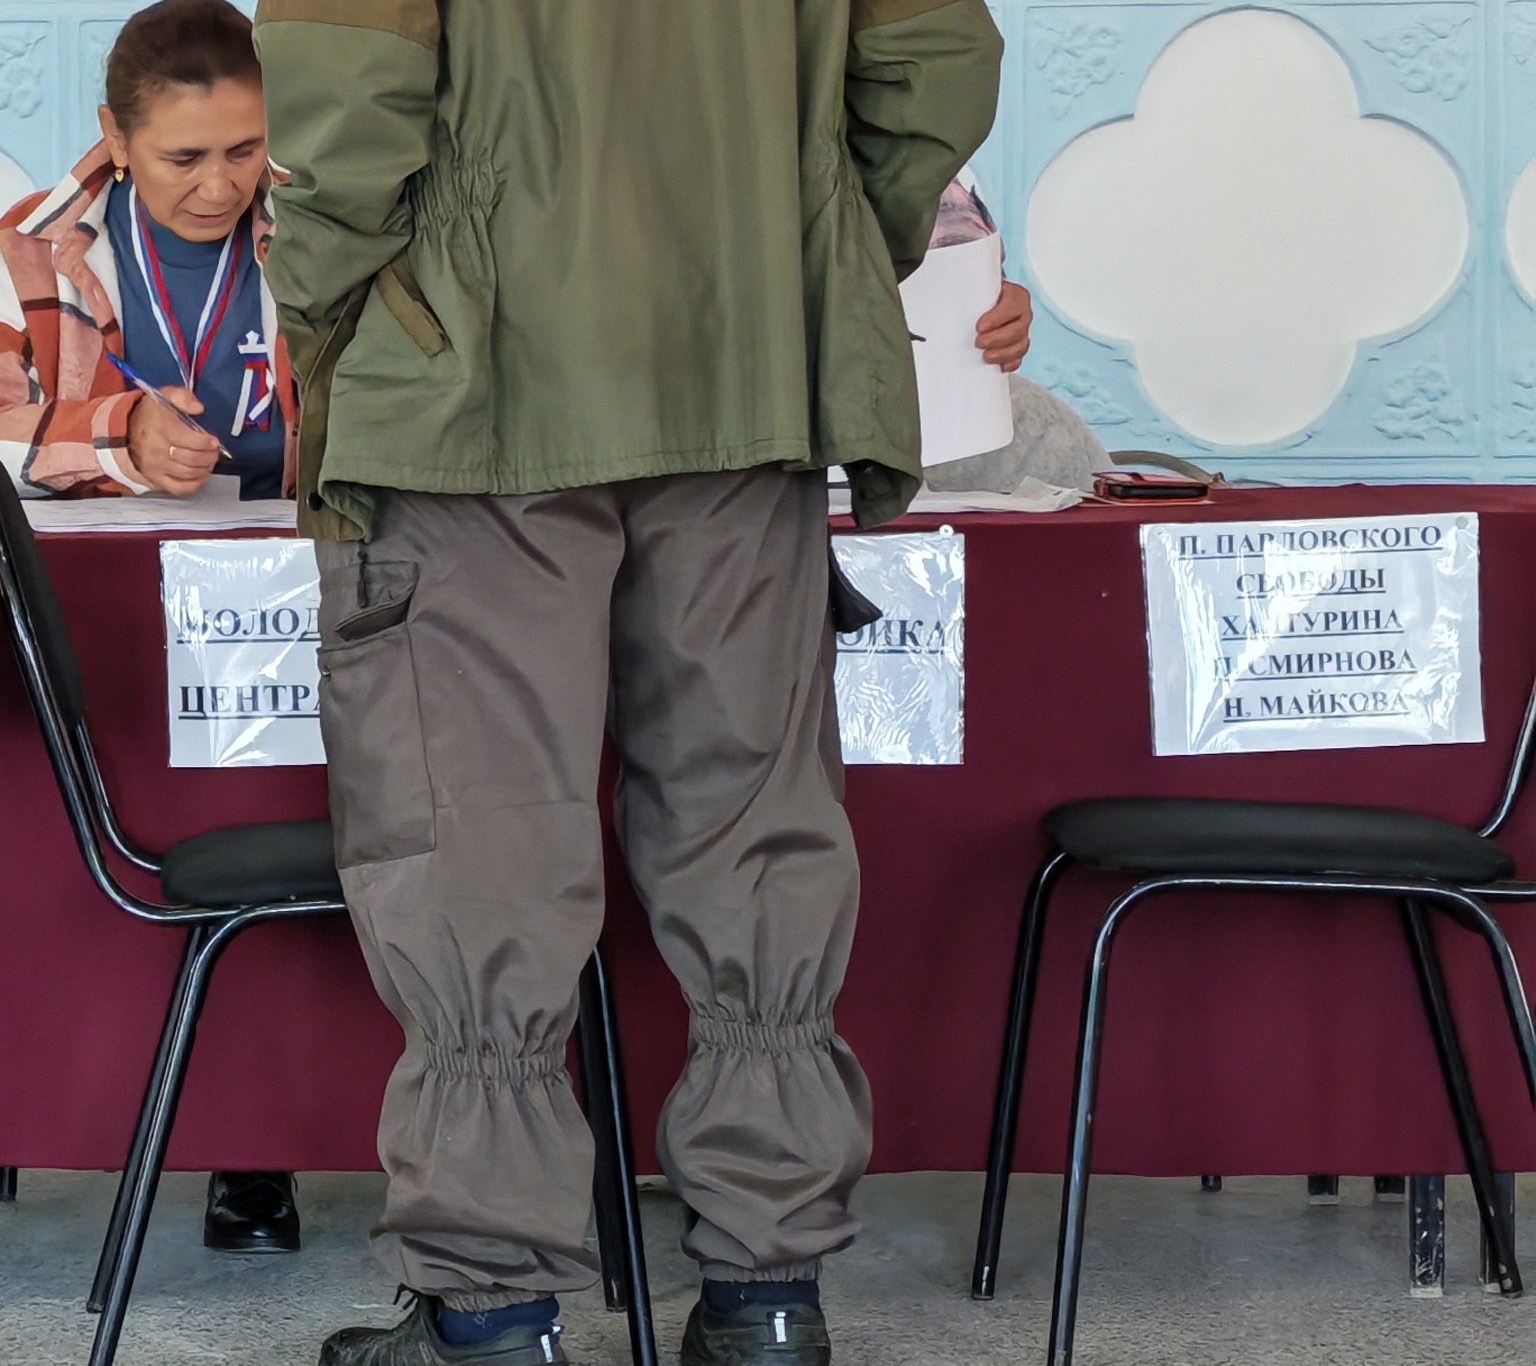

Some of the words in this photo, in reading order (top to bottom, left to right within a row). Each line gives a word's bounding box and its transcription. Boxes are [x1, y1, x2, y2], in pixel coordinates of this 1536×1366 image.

[1179, 534, 1207, 556] П.
[1248, 648, 1417, 676] СМИРНОВА
[178, 684, 321, 716] ЦЕНТР
[1260, 688, 1410, 716] МАЙКОВА
